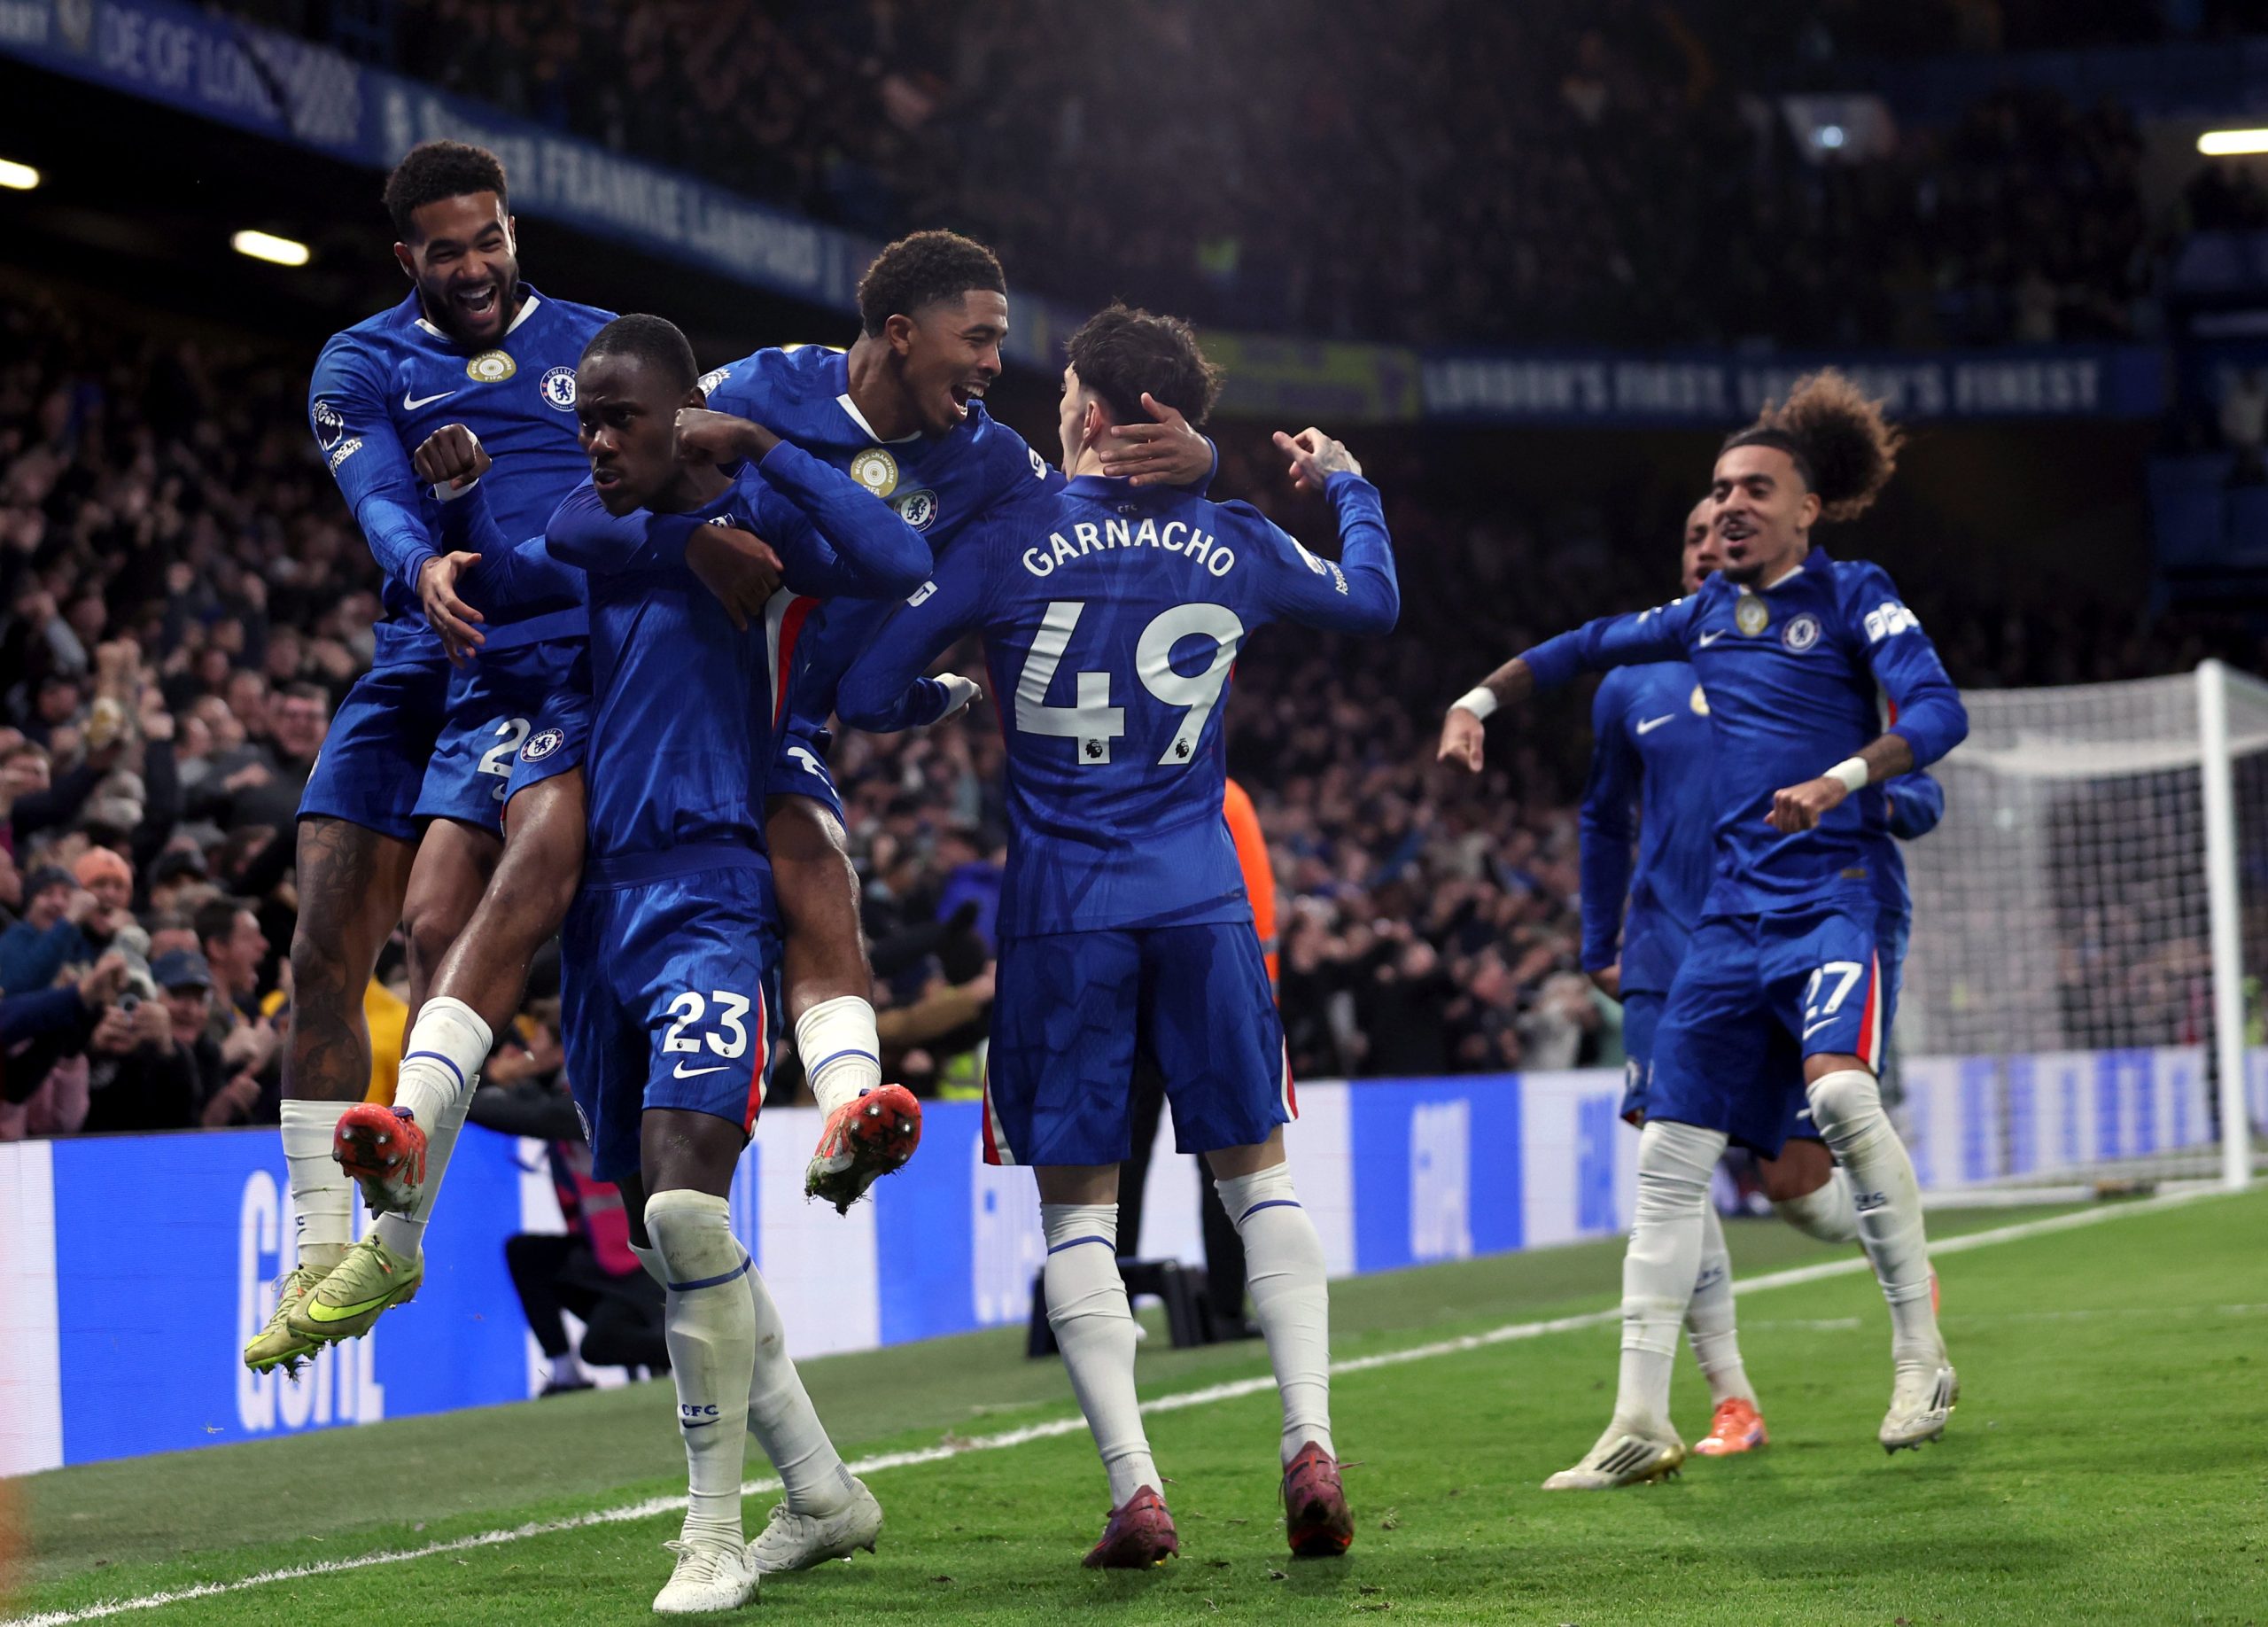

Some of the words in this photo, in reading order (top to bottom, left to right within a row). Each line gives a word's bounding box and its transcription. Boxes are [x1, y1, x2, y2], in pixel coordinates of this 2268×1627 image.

[547, 367, 577, 379] CHELSEA
[854, 453, 870, 475] WORLD
[871, 451, 895, 484] CHAMPIONS
[1118, 503, 1138, 513] CFC
[1021, 518, 1236, 577] GARNACHO
[1014, 601, 1245, 766] 49
[662, 990, 750, 1059] 23
[681, 1403, 719, 1417] CFC
